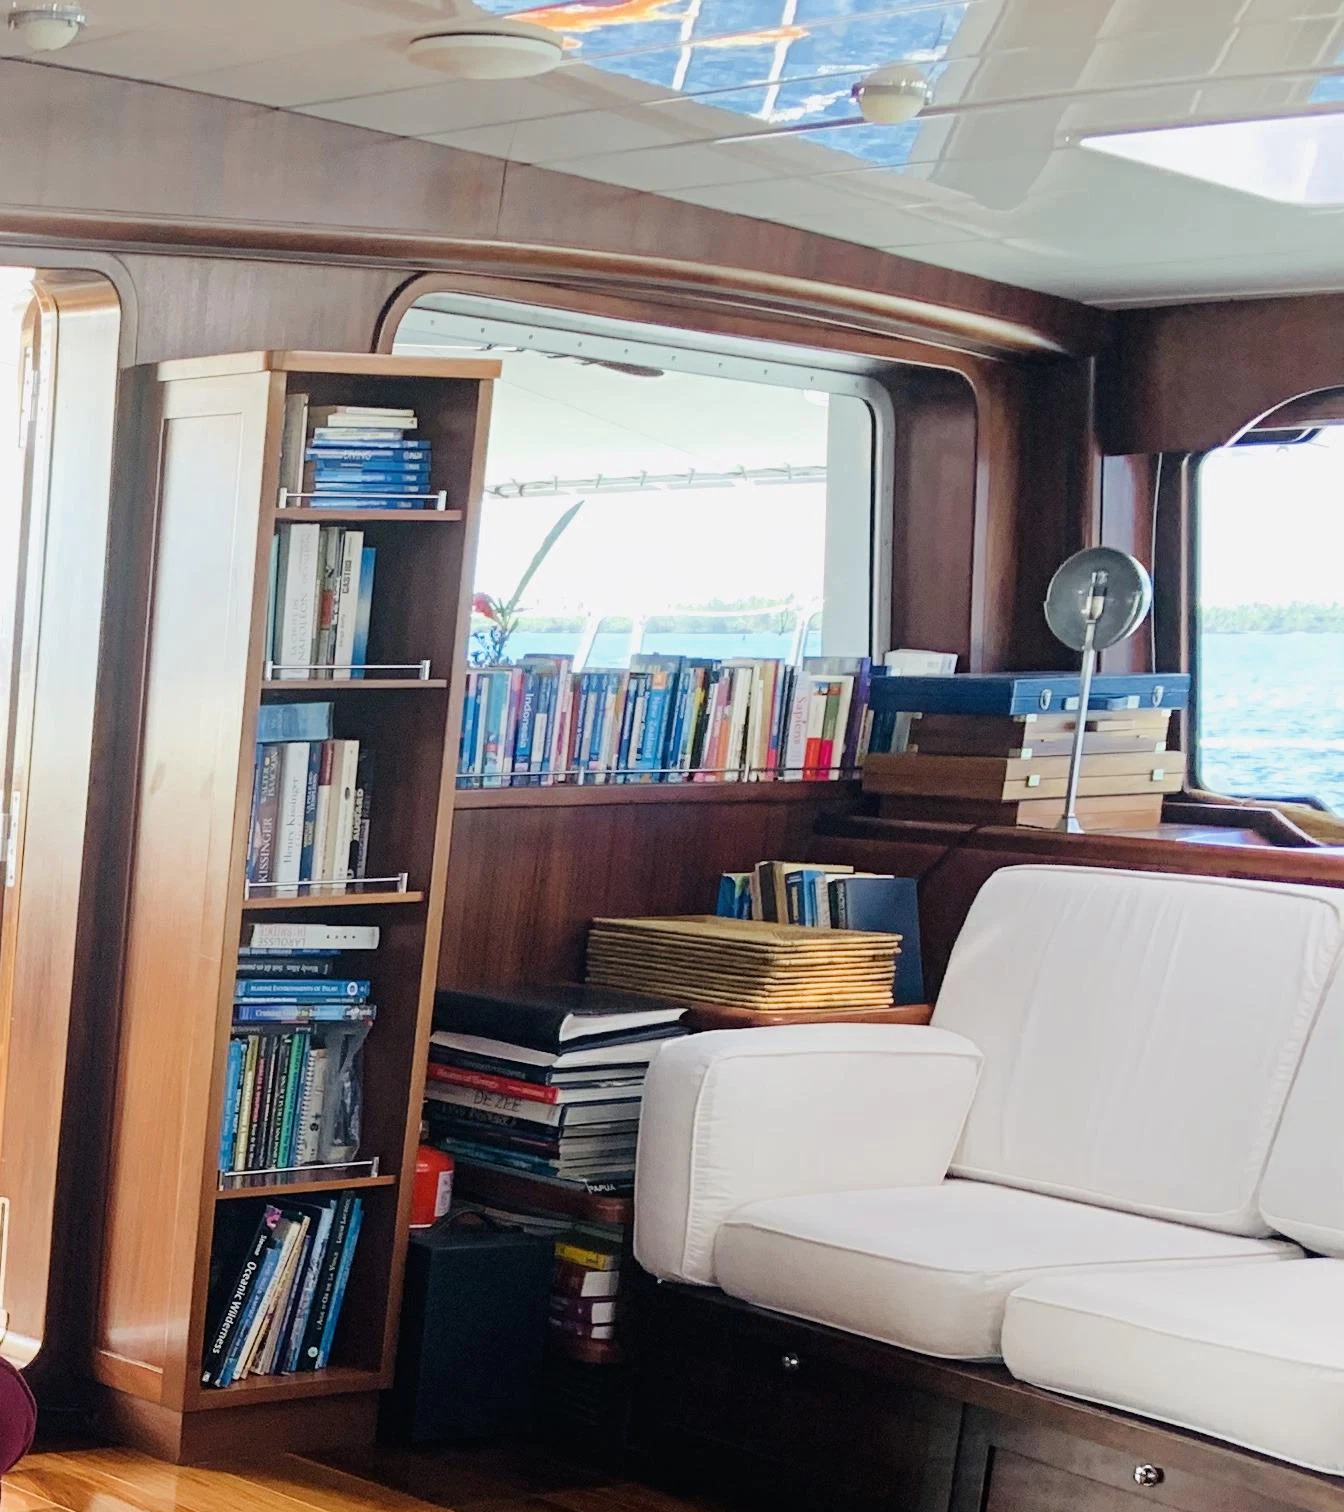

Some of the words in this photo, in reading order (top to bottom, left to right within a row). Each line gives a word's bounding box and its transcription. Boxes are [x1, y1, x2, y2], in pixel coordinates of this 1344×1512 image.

[520, 693, 534, 748] Indonesia
[792, 696, 808, 745] Sapiens
[258, 817, 272, 882] KISSINGER
[473, 1090, 492, 1107] DE
[494, 1095, 522, 1112] ZEE
[233, 1261, 257, 1302] Oceanic
[212, 1301, 242, 1354] Wilderness
